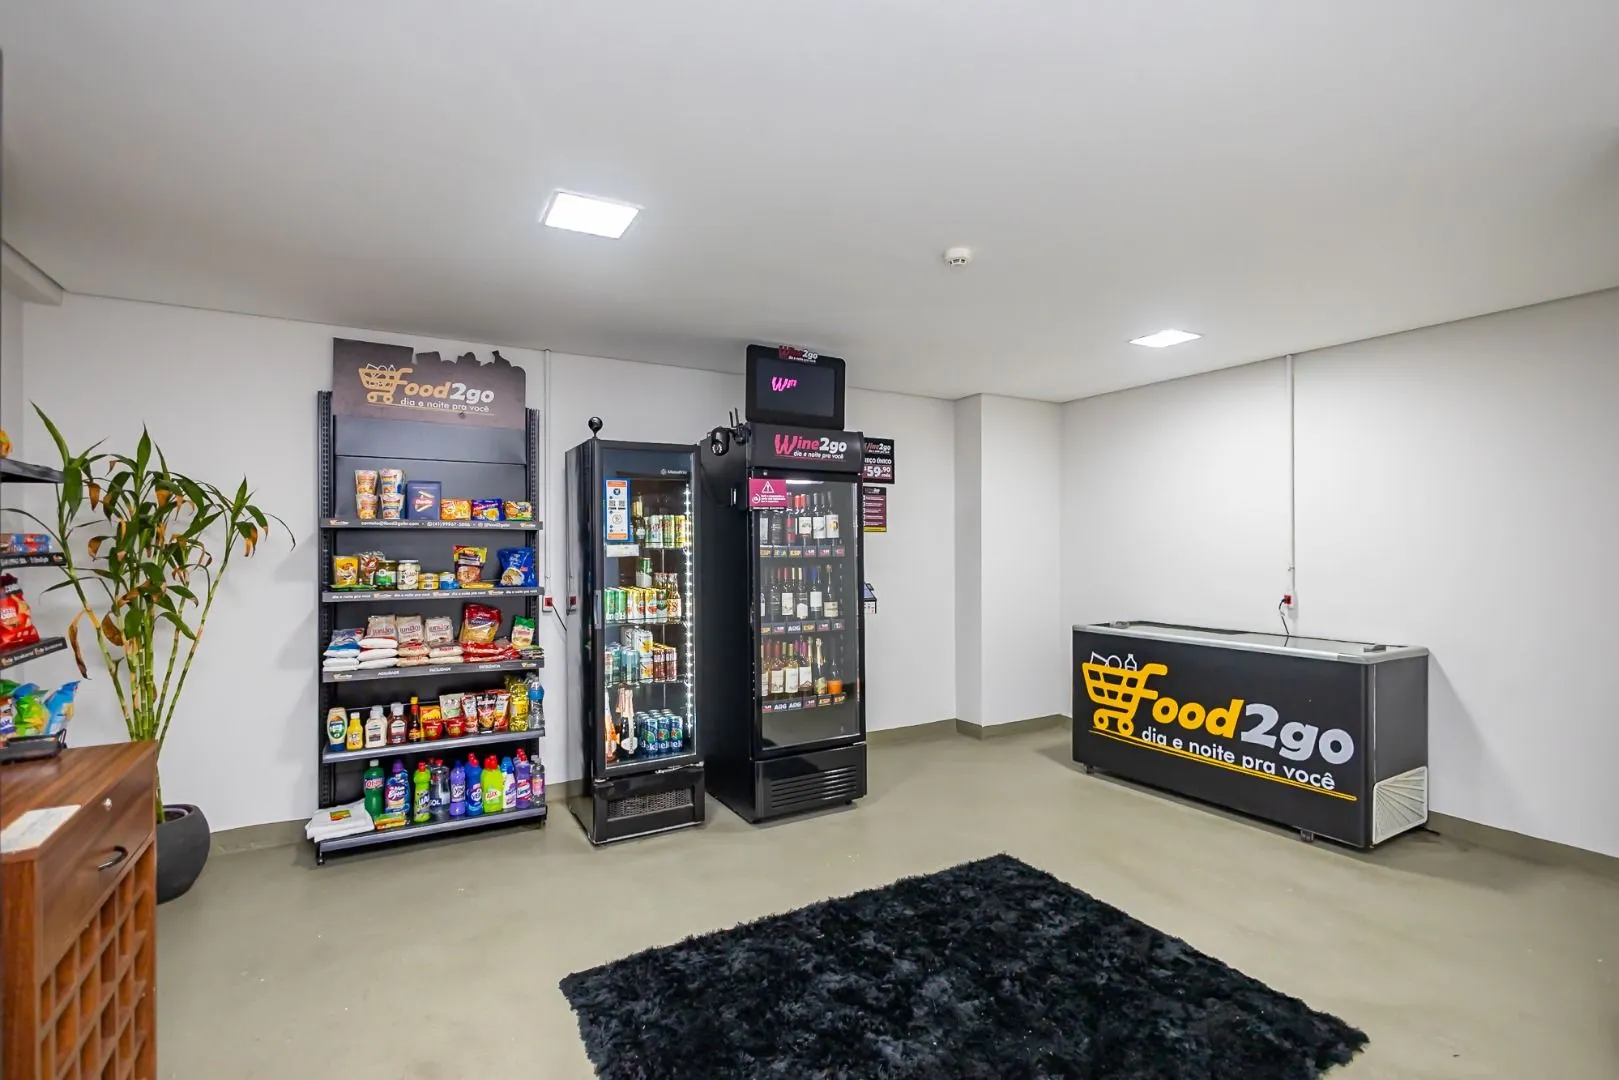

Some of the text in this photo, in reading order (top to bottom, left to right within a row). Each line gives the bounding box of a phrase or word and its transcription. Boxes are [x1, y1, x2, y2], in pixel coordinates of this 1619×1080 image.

[400, 398, 416, 406] dia
[427, 400, 450, 409] noite
[452, 404, 467, 413] pra
[774, 434, 848, 454] Wine2go
[1142, 726, 1336, 790] dia e noite pra você
